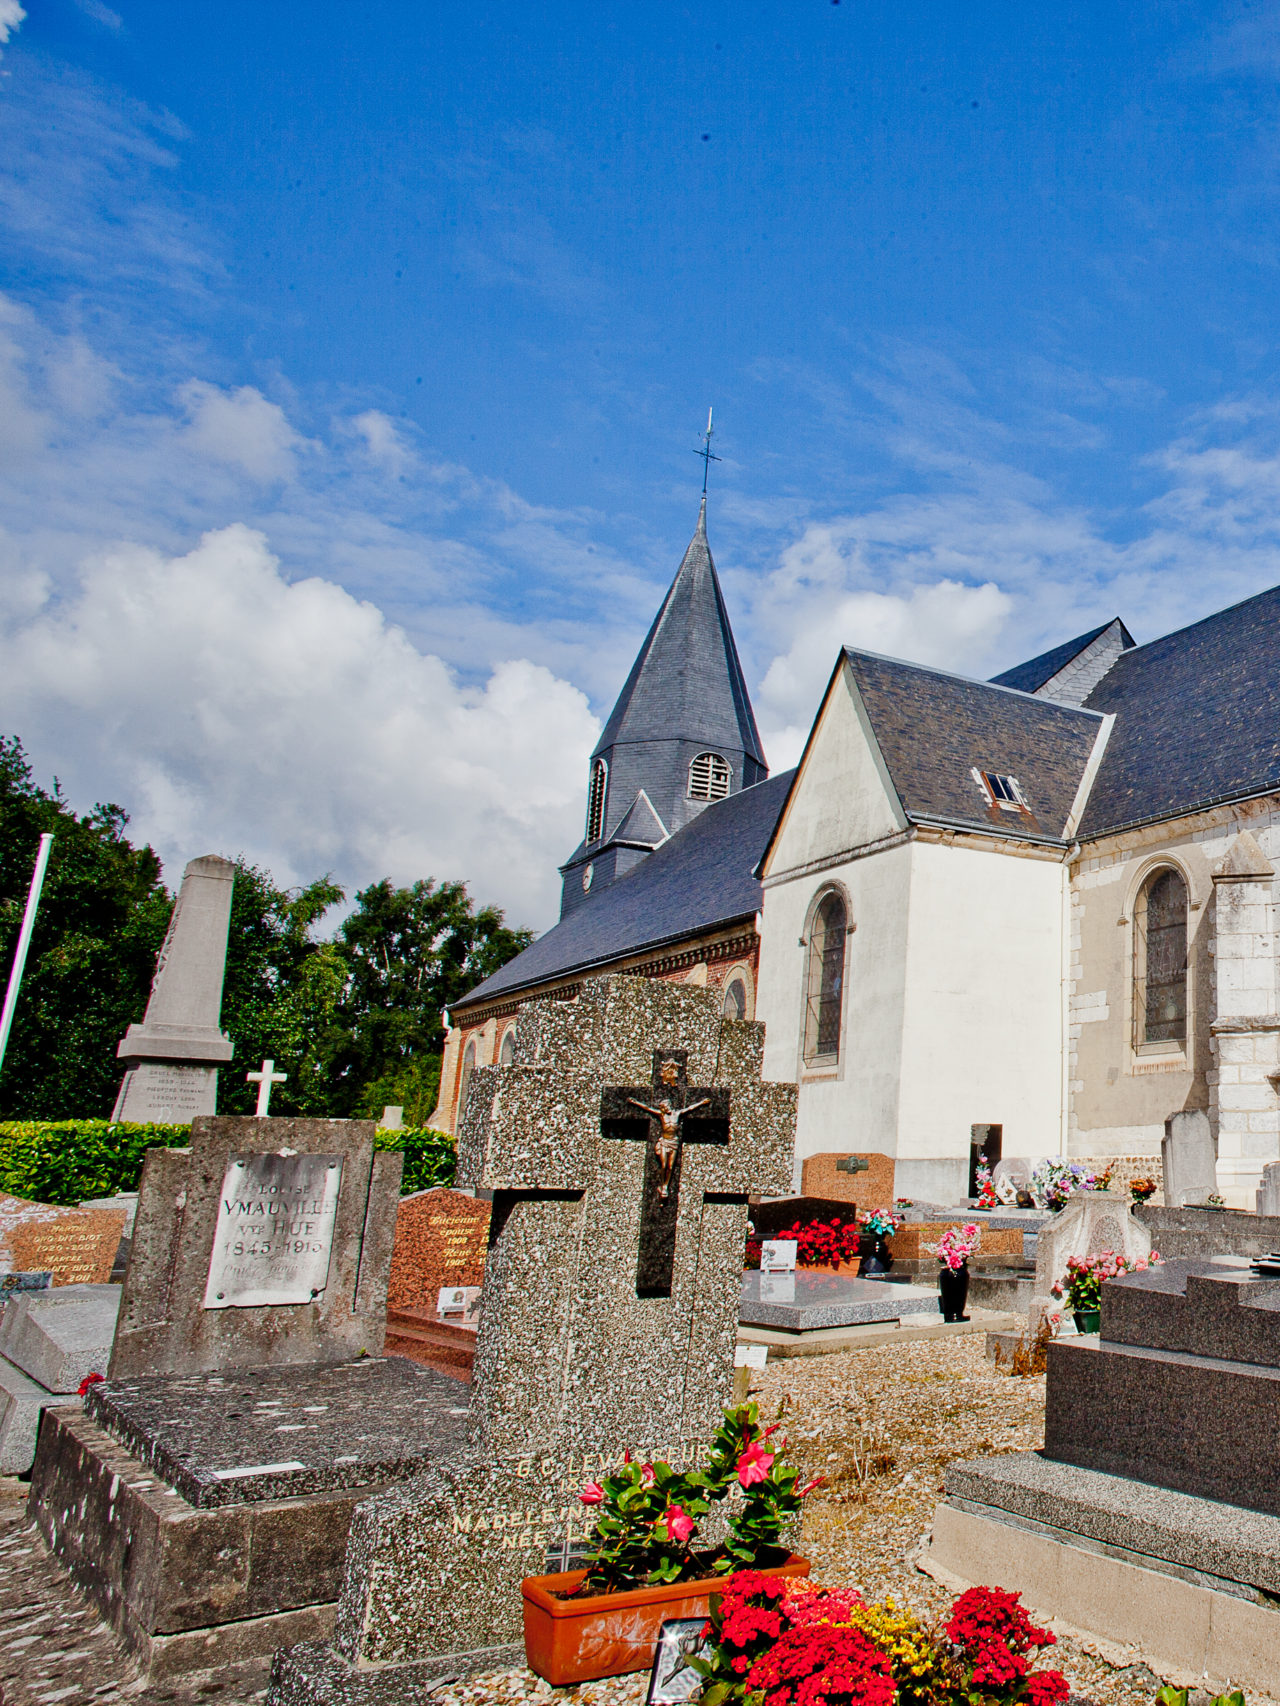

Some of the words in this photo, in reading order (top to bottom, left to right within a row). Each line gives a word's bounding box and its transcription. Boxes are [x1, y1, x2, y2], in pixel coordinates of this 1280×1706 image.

[273, 1220, 316, 1235] HUE
[568, 1444, 710, 1473] LEVASSEUR
[452, 1505, 598, 1535] MADELEINE
